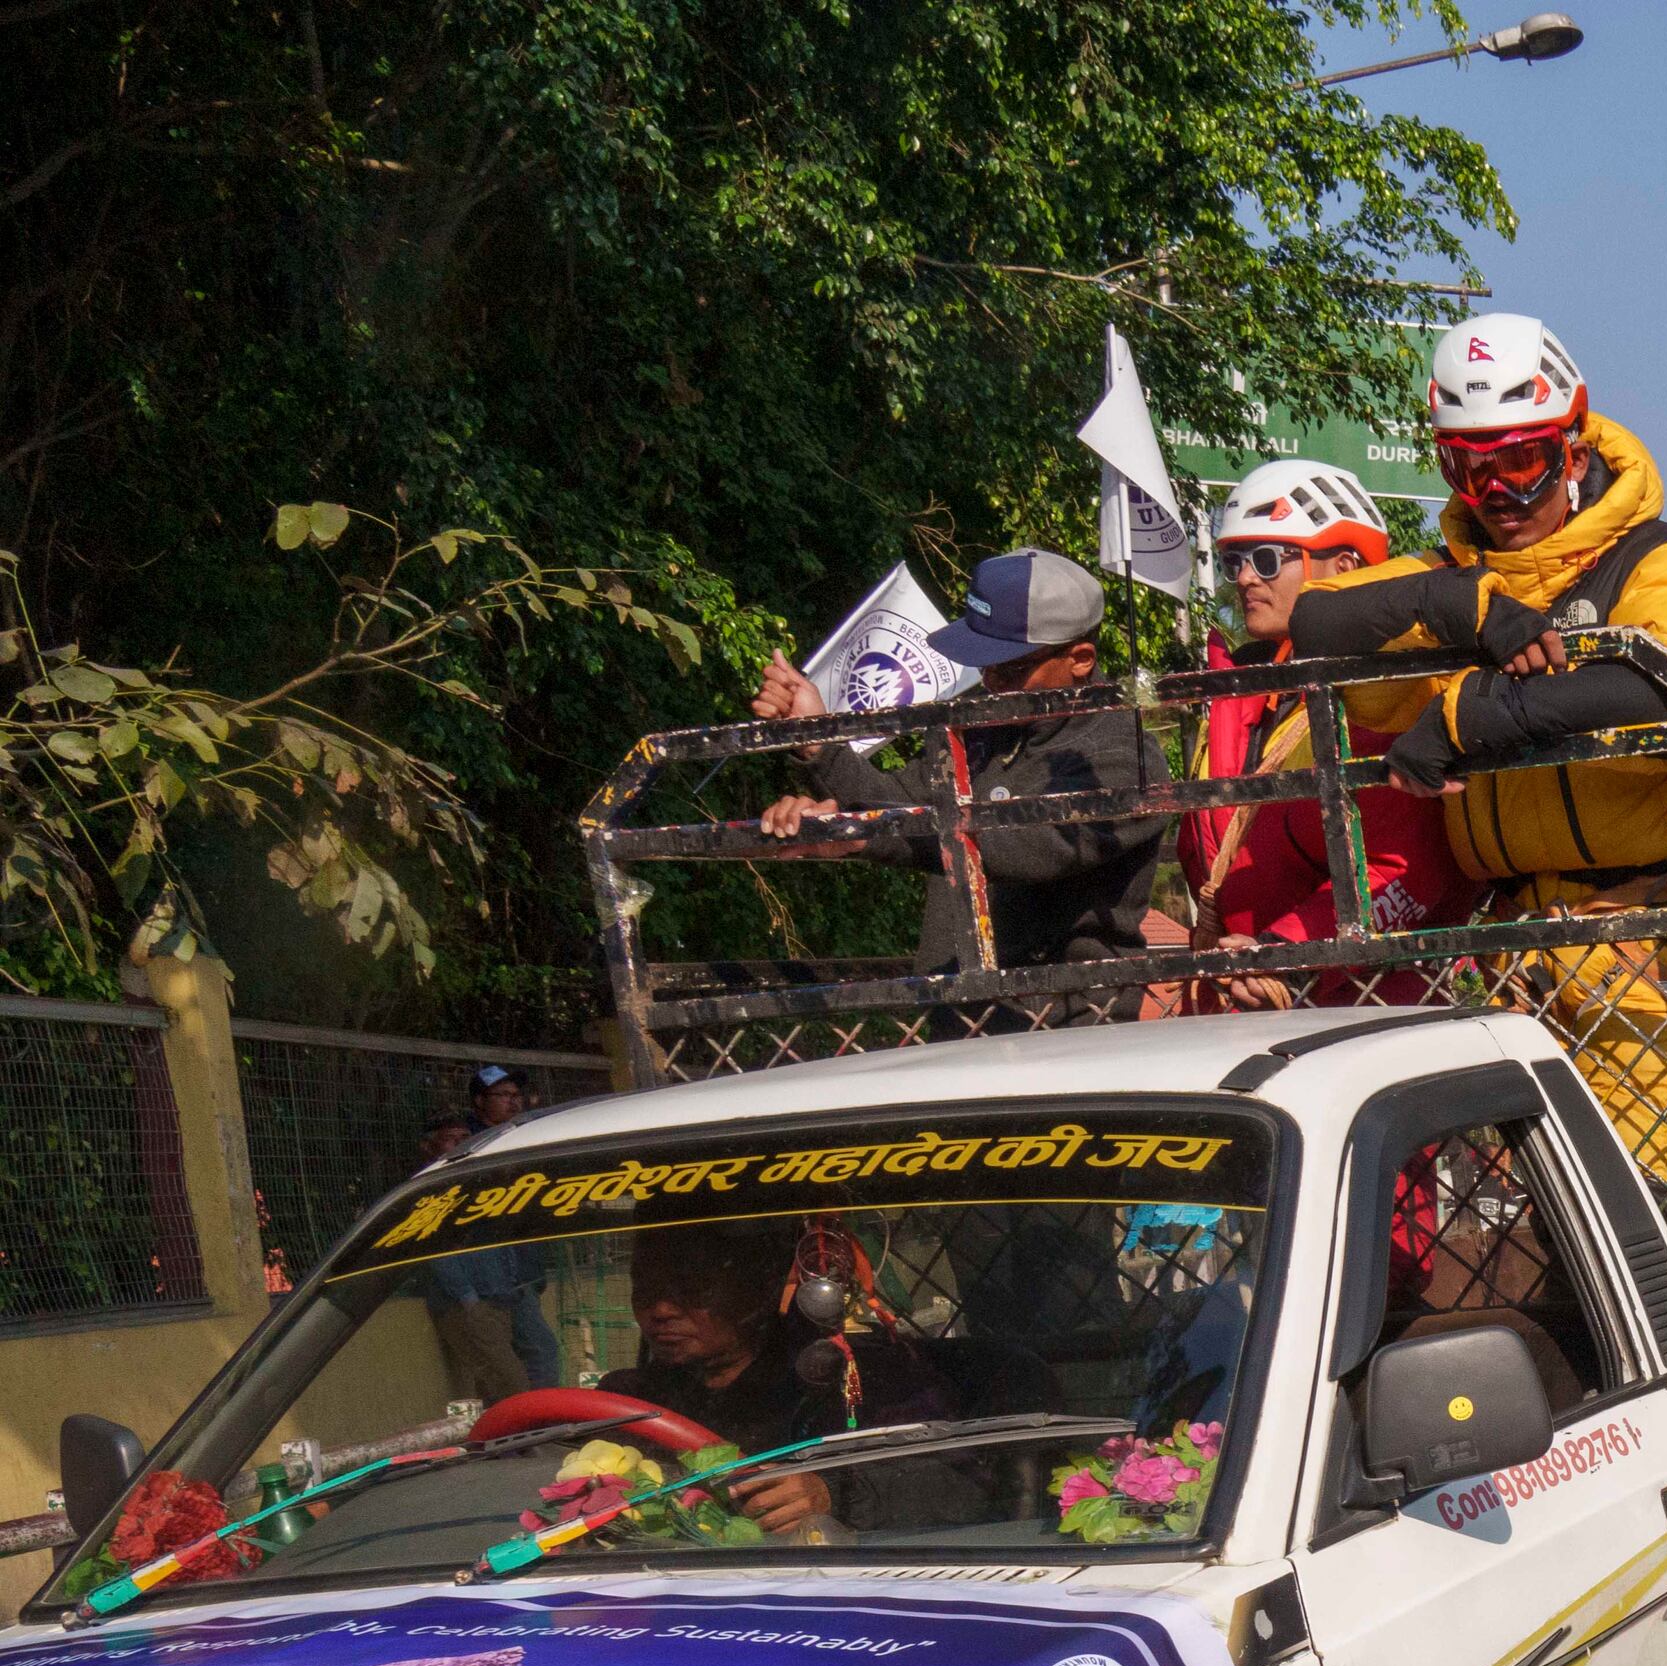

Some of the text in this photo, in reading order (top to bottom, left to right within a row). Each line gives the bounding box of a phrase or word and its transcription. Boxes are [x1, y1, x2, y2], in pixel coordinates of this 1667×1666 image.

[891, 641, 932, 685] IVBV
[454, 1172, 550, 1226] श्री
[758, 1131, 992, 1184] महादेव
[982, 1124, 1094, 1170] की
[1088, 1132, 1233, 1172] जय
[151, 1620, 396, 1654] Responsbly,
[406, 1623, 650, 1640] Celebrating
